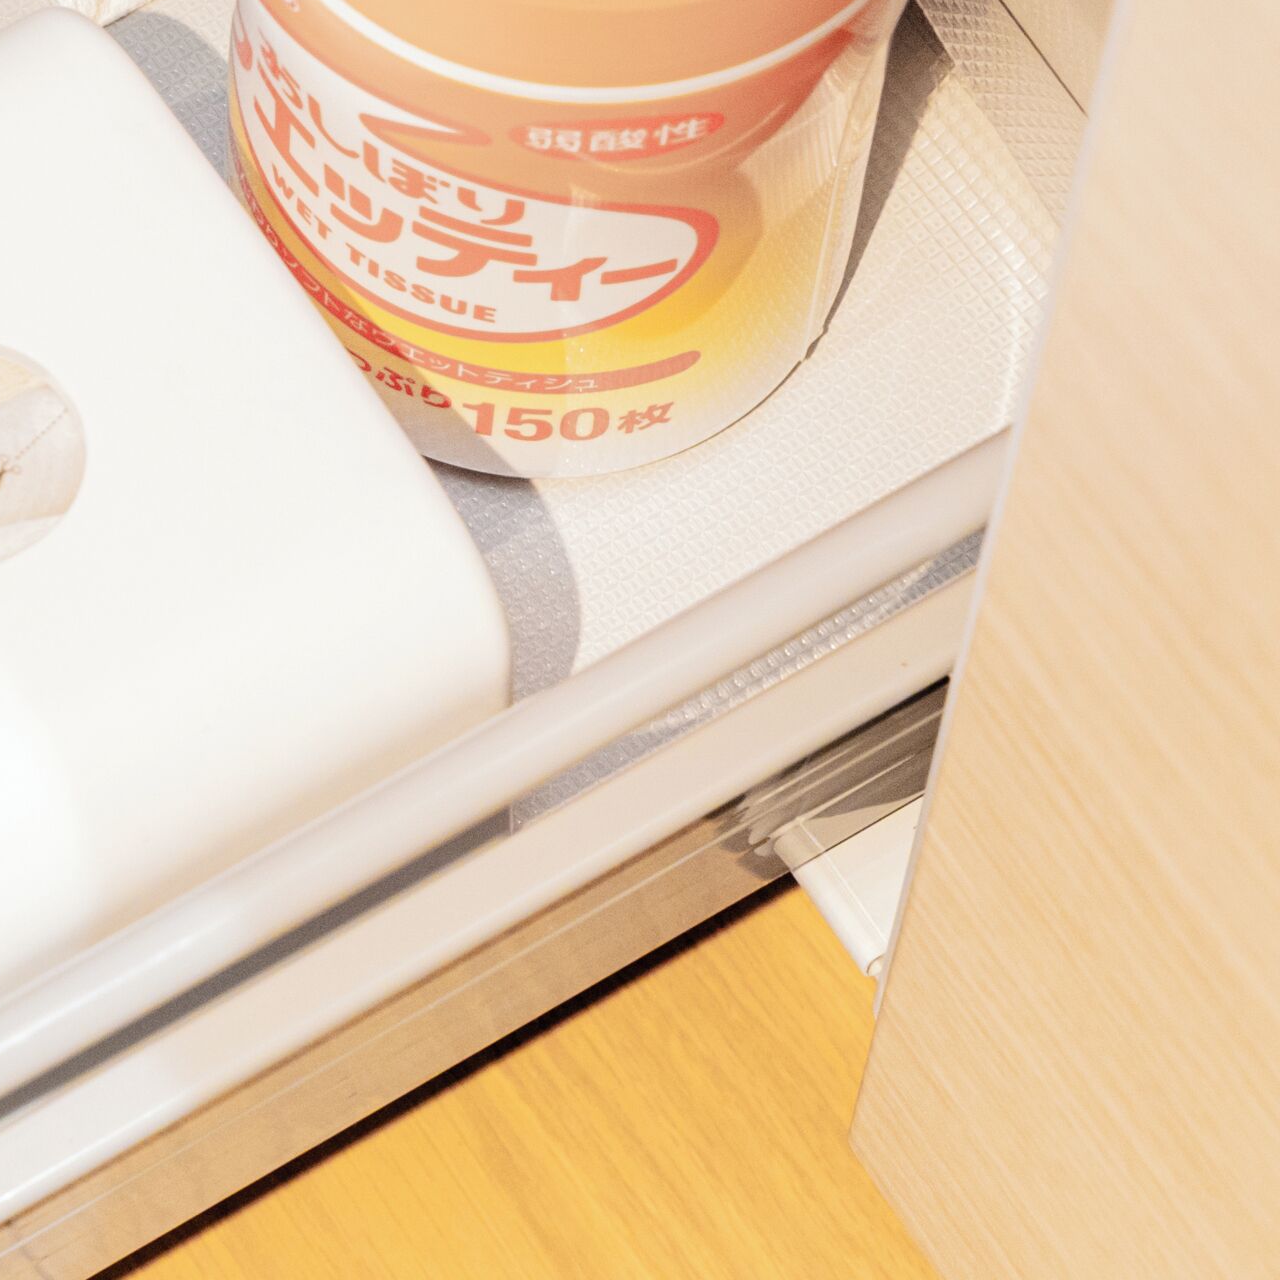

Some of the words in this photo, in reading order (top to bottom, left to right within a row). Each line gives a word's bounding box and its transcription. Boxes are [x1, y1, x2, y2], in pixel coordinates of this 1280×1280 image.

[258, 27, 525, 227] おしぼり
[526, 117, 707, 153] 弱酸性
[271, 163, 333, 241] WET
[344, 241, 497, 324] TISSUE
